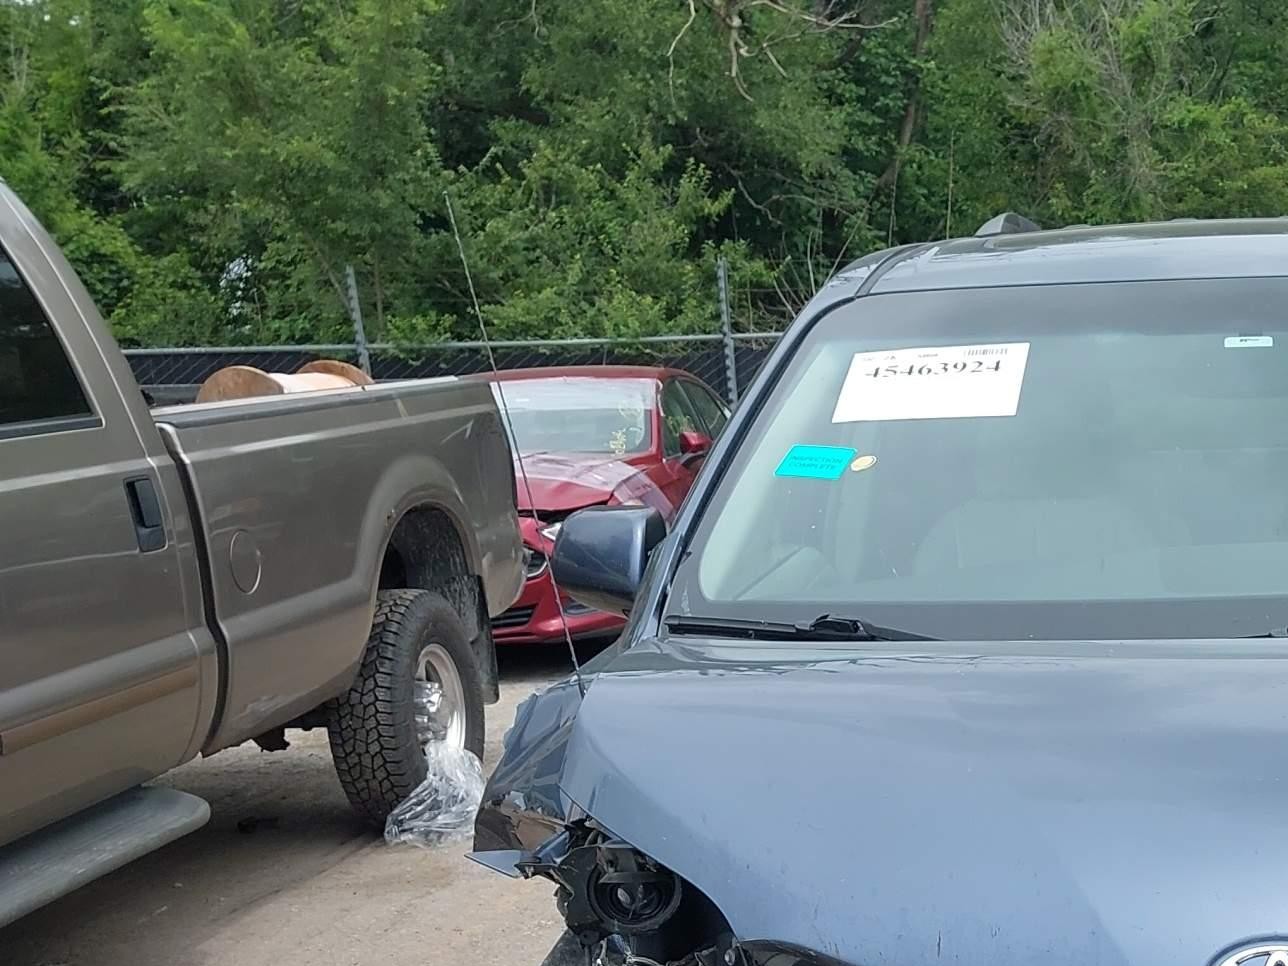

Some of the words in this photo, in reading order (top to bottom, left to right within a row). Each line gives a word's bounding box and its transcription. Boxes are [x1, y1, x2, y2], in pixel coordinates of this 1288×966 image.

[865, 360, 1001, 378] 45463924
[792, 455, 843, 464] INSPECTION
[788, 461, 836, 471] COMPLETE
